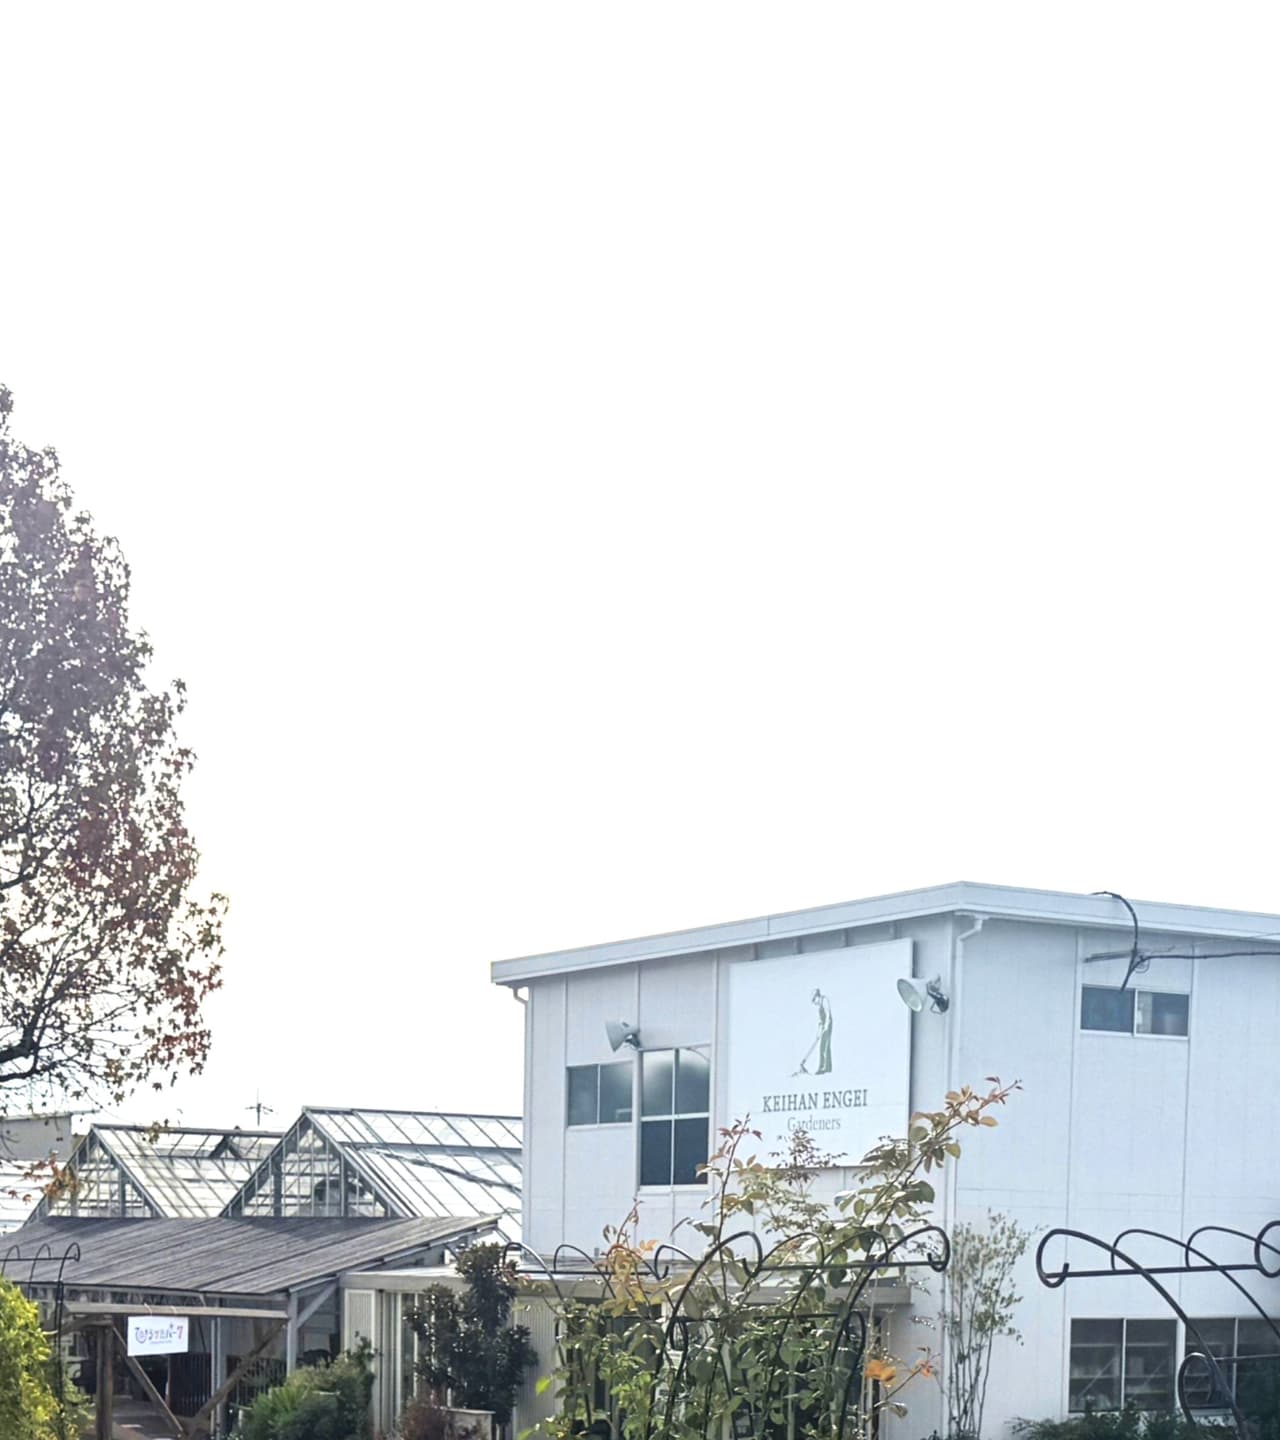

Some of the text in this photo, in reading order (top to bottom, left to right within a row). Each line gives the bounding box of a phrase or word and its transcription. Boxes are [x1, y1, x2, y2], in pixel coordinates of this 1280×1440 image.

[762, 1088, 868, 1113] KEIHAN ENGEI
[787, 1114, 841, 1132] Gardeners
